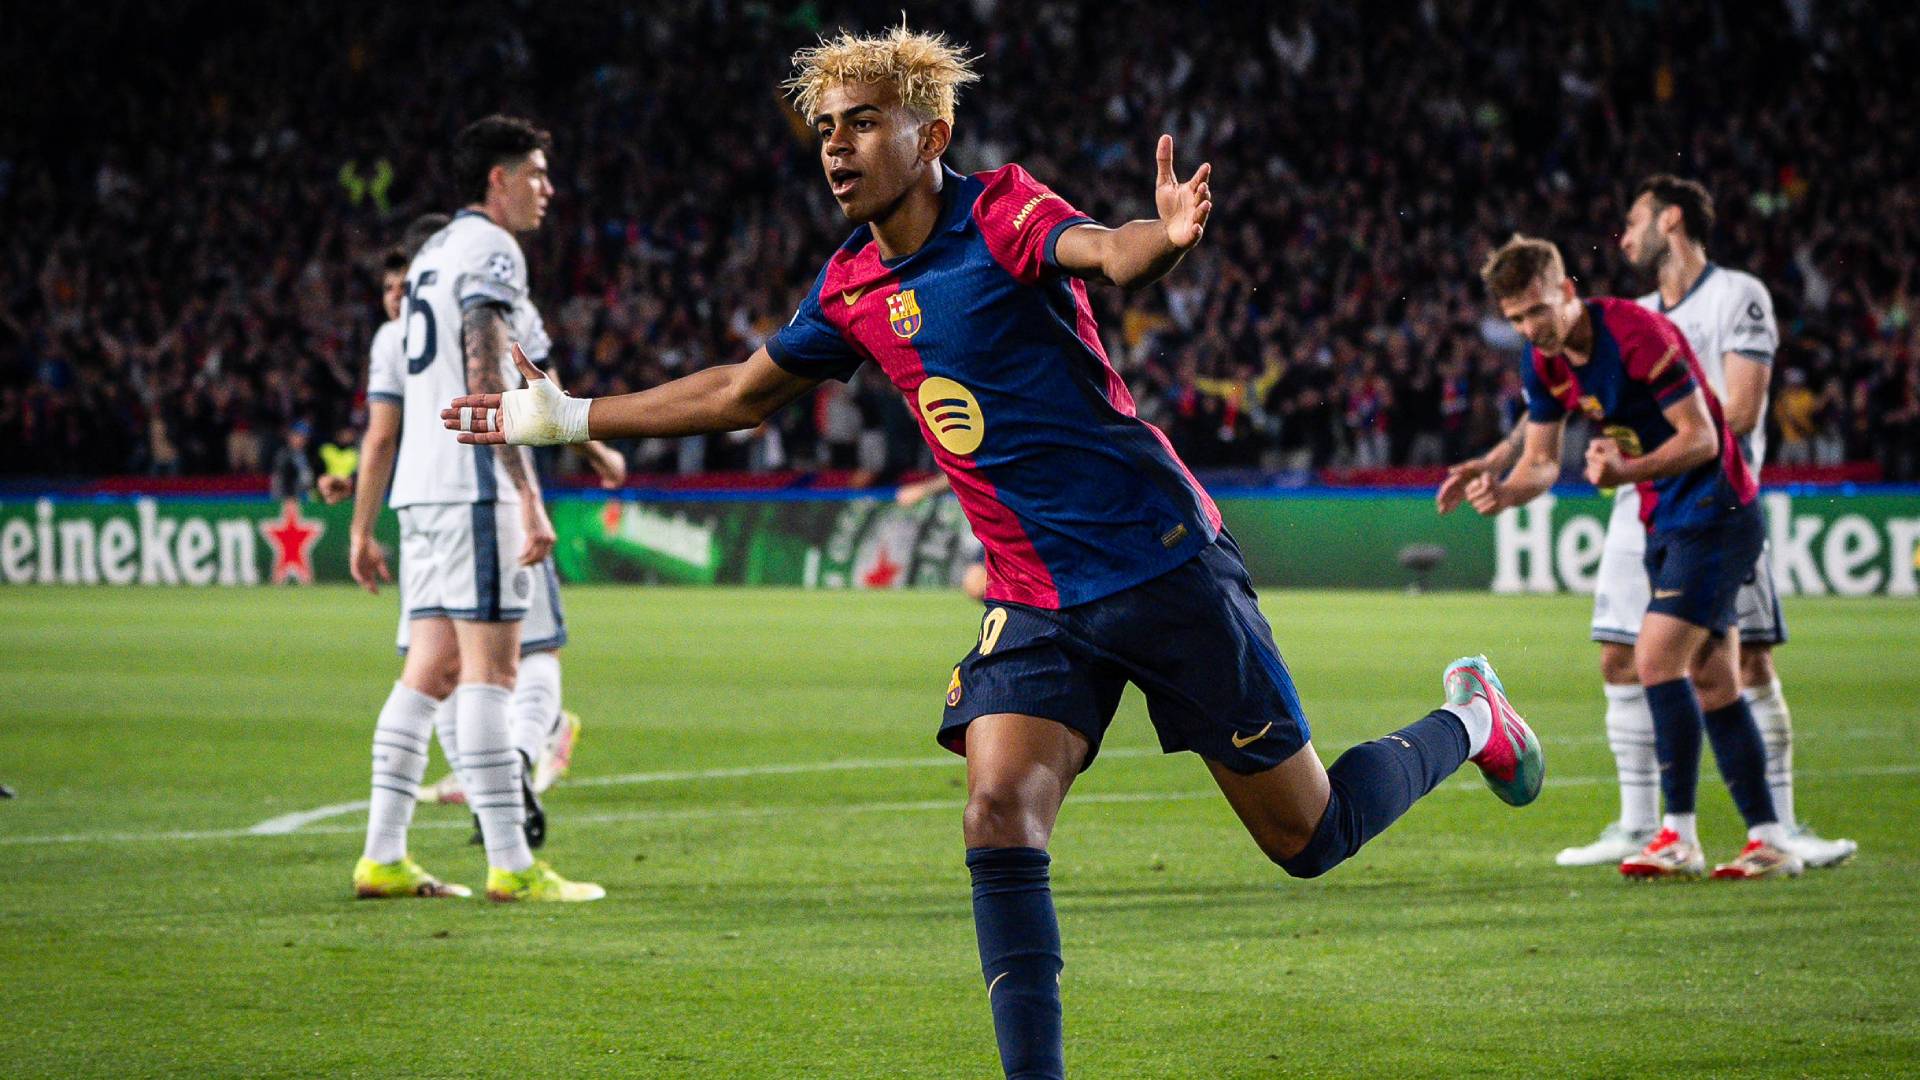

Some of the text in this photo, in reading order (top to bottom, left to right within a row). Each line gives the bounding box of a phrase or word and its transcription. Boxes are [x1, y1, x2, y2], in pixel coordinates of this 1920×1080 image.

[403, 270, 438, 375] 5
[0, 496, 259, 584] eineken
[979, 607, 1008, 656] 0
